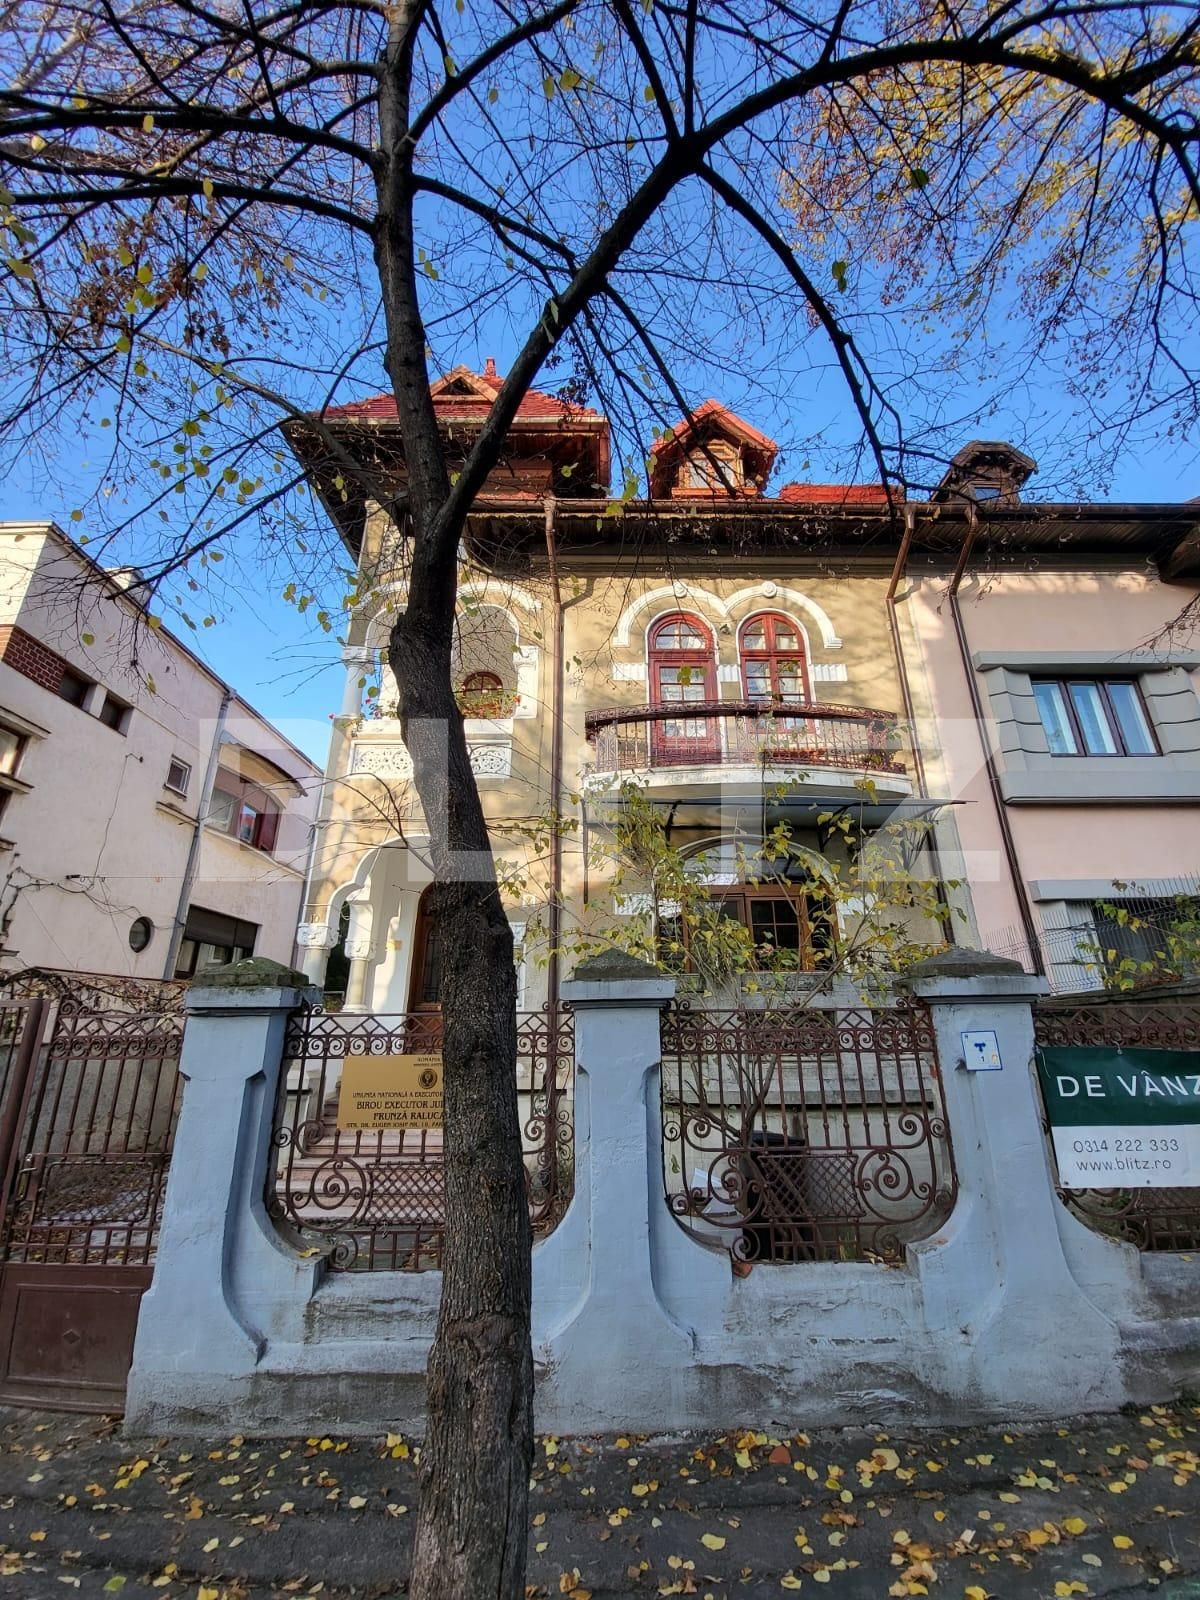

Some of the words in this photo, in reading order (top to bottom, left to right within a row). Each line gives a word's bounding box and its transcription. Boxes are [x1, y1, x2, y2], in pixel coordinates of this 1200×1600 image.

[1056, 1075, 1106, 1097] DE
[357, 1101, 382, 1110] BIROU
[385, 1100, 428, 1109] EXECUTOR
[373, 1110, 408, 1121] FRUNZĂ
[1073, 1140, 1108, 1153] 0314
[1115, 1139, 1143, 1152] 222
[1150, 1139, 1179, 1152] 333
[1076, 1156, 1172, 1171] www.blitz.ro
